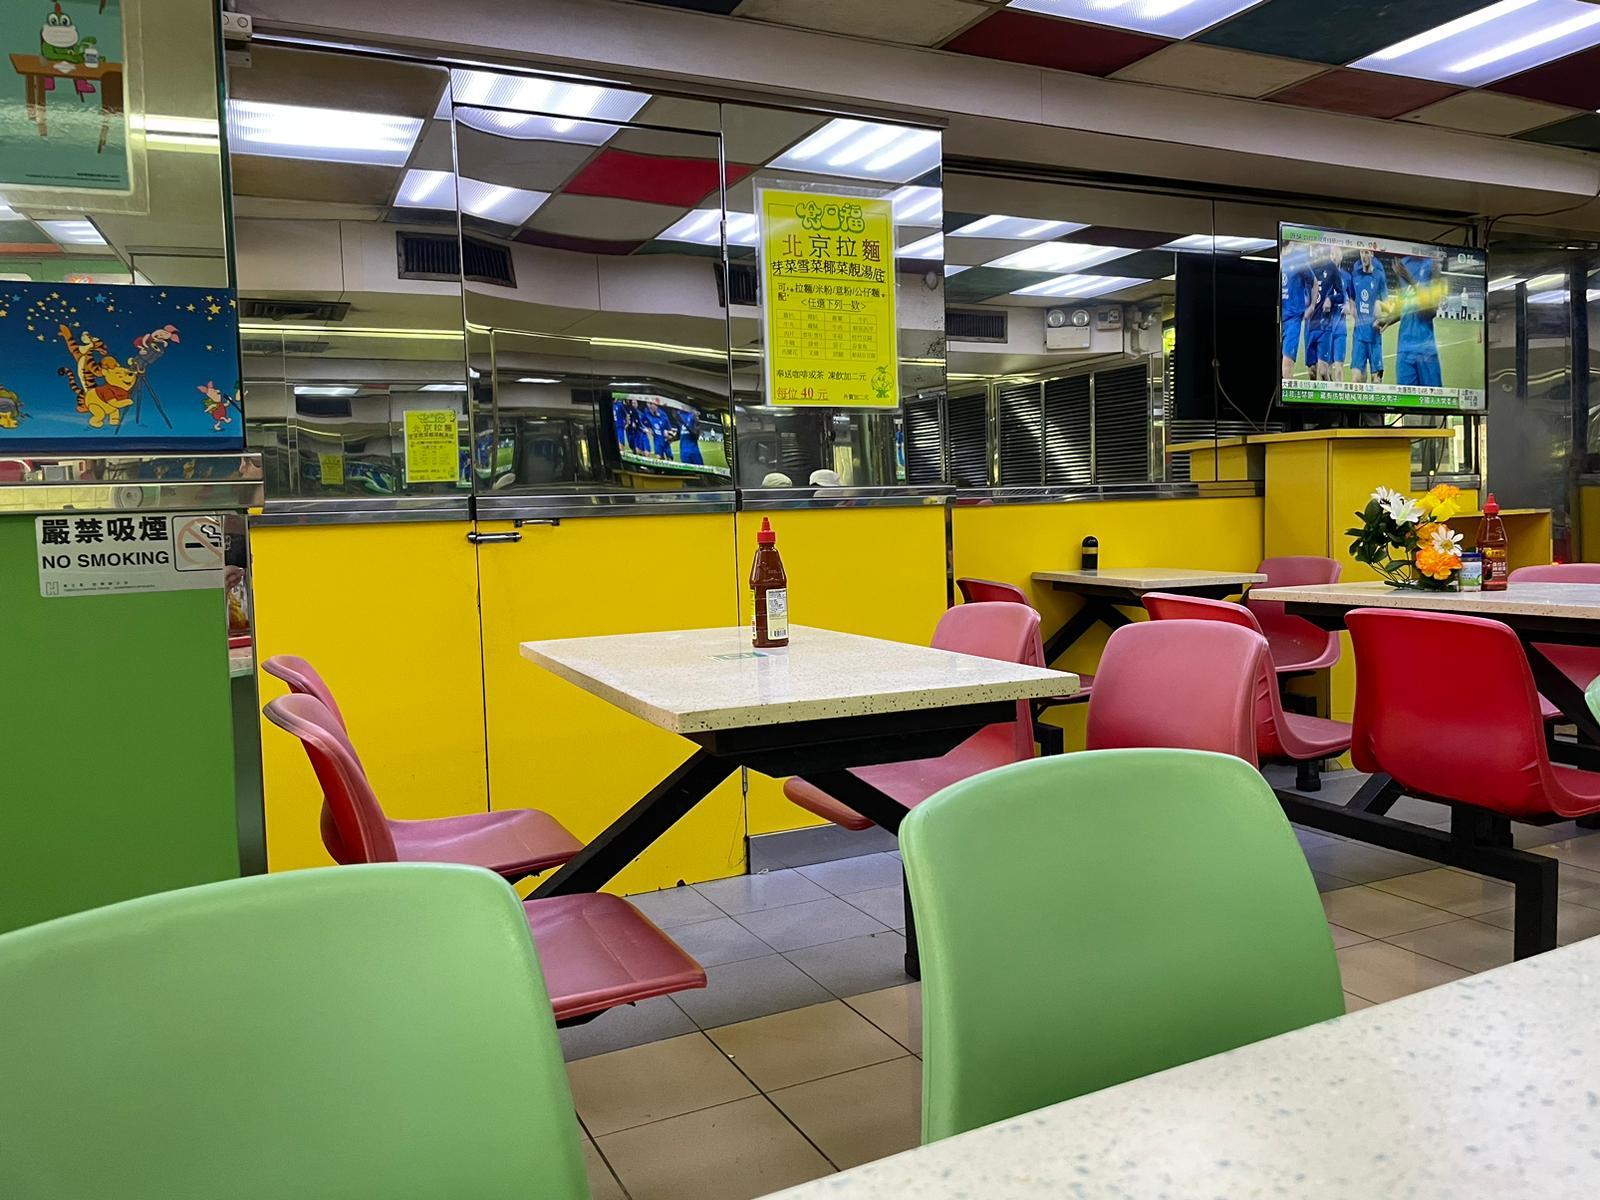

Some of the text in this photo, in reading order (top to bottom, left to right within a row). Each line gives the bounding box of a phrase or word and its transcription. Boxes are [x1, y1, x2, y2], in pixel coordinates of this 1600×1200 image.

[782, 233, 881, 262] 北京拉麵
[777, 386, 829, 400] 每位 40 元
[41, 515, 169, 545] 嚴禁吸煙
[42, 550, 169, 569] NO SMOKING
